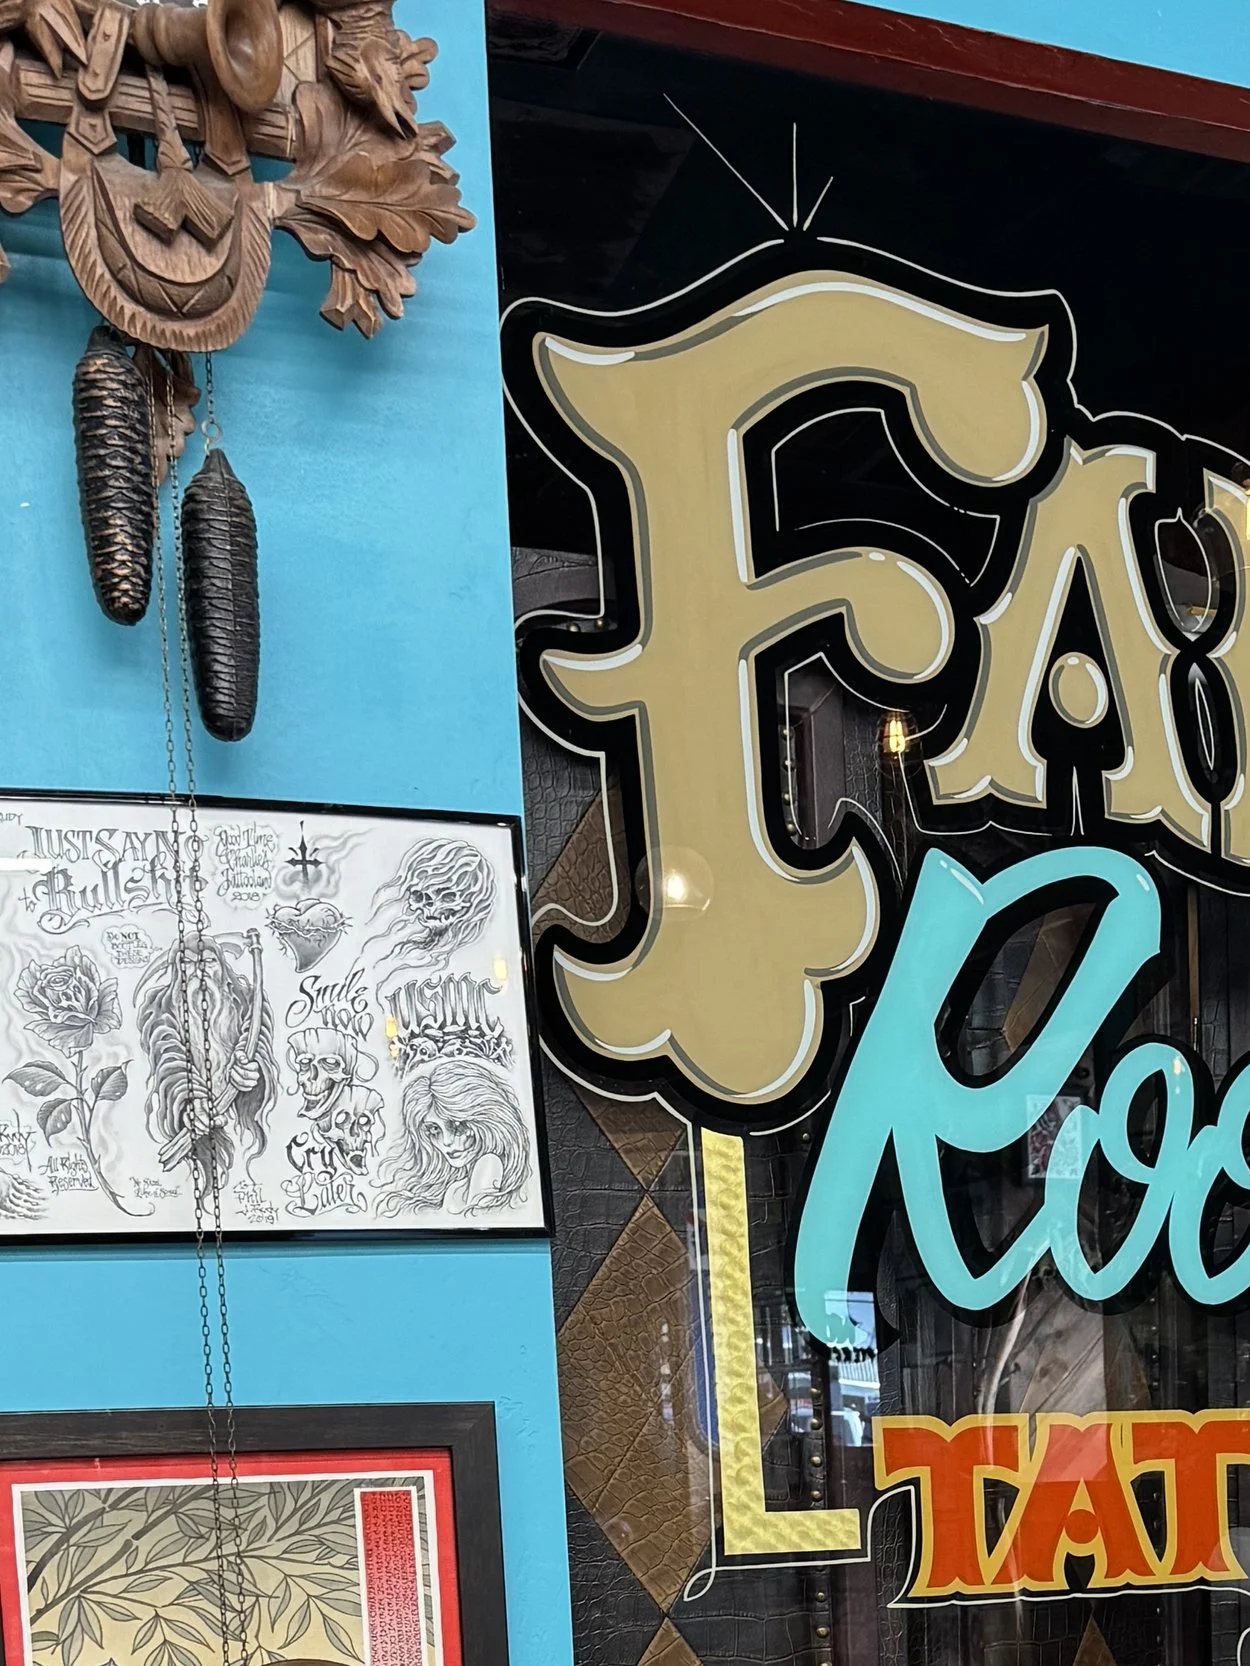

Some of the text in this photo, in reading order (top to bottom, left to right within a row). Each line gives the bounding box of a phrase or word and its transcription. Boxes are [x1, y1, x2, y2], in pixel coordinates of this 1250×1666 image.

[0, 811, 23, 825] UDY
[25, 826, 93, 863] JUST
[92, 829, 153, 872] SAY
[231, 891, 260, 901] 2018
[286, 970, 369, 1027] Smile
